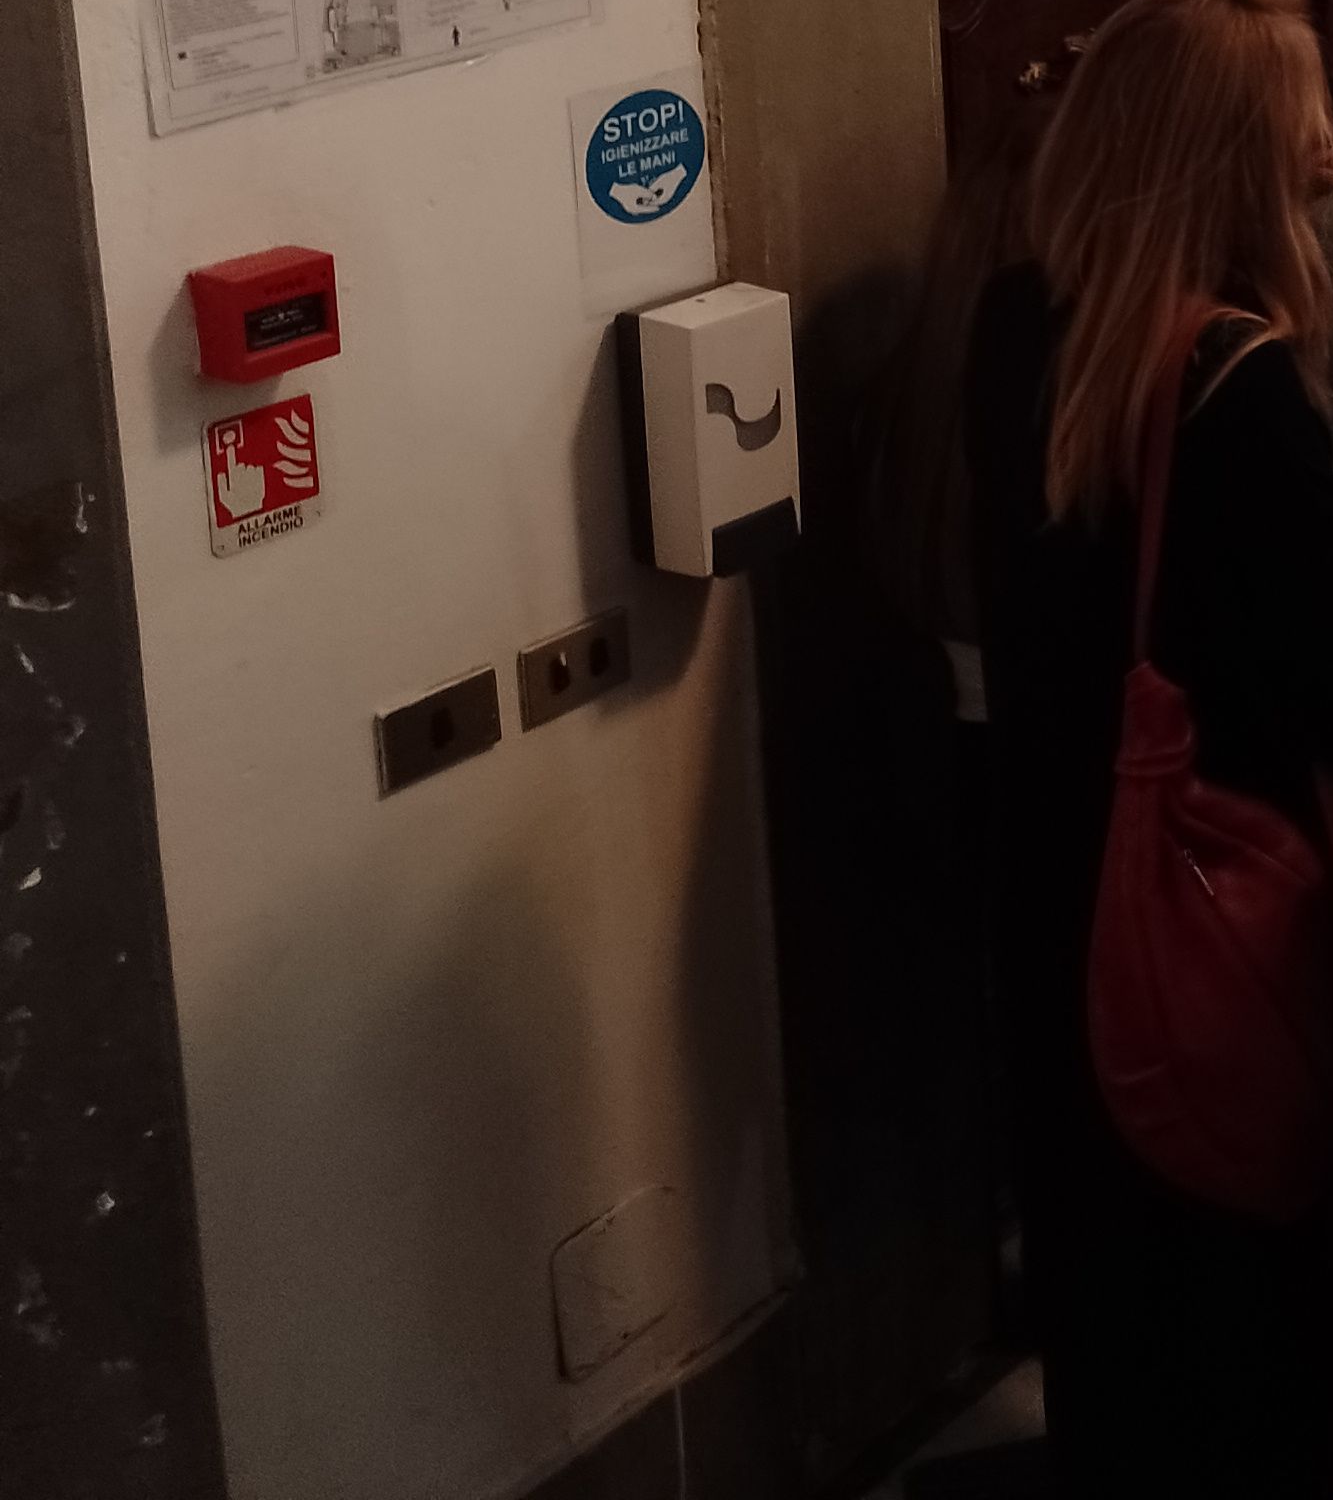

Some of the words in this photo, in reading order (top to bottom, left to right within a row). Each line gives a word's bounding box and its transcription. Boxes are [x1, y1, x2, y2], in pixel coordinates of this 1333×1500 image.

[602, 128, 689, 165] IGIENIZZARE
[619, 161, 637, 178] LE
[641, 150, 676, 172] MANI
[239, 505, 303, 535] ALLARME
[239, 515, 304, 548] INCENDIO
